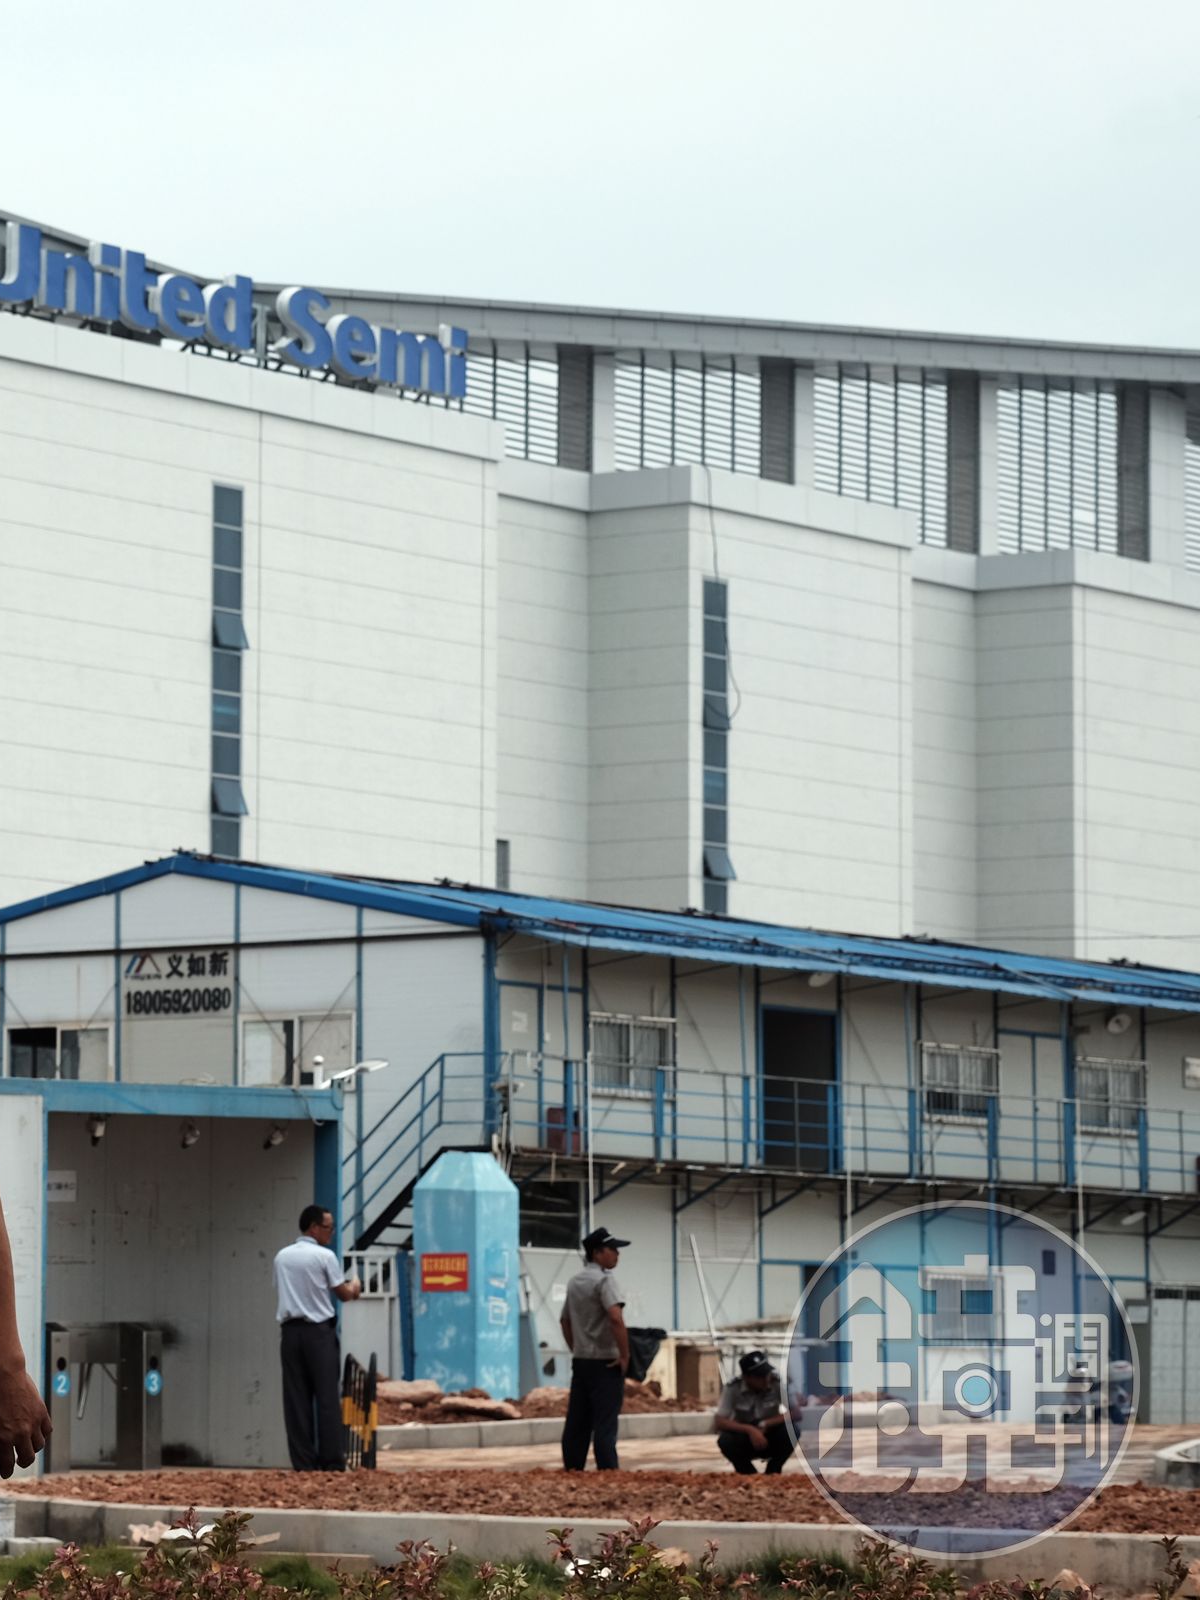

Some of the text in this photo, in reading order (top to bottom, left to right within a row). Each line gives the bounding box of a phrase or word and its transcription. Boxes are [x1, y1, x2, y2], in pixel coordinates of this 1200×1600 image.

[276, 286, 468, 400] Semi
[126, 987, 231, 1015] 18005920080
[57, 1375, 66, 1393] 2
[150, 1374, 159, 1393] 3
